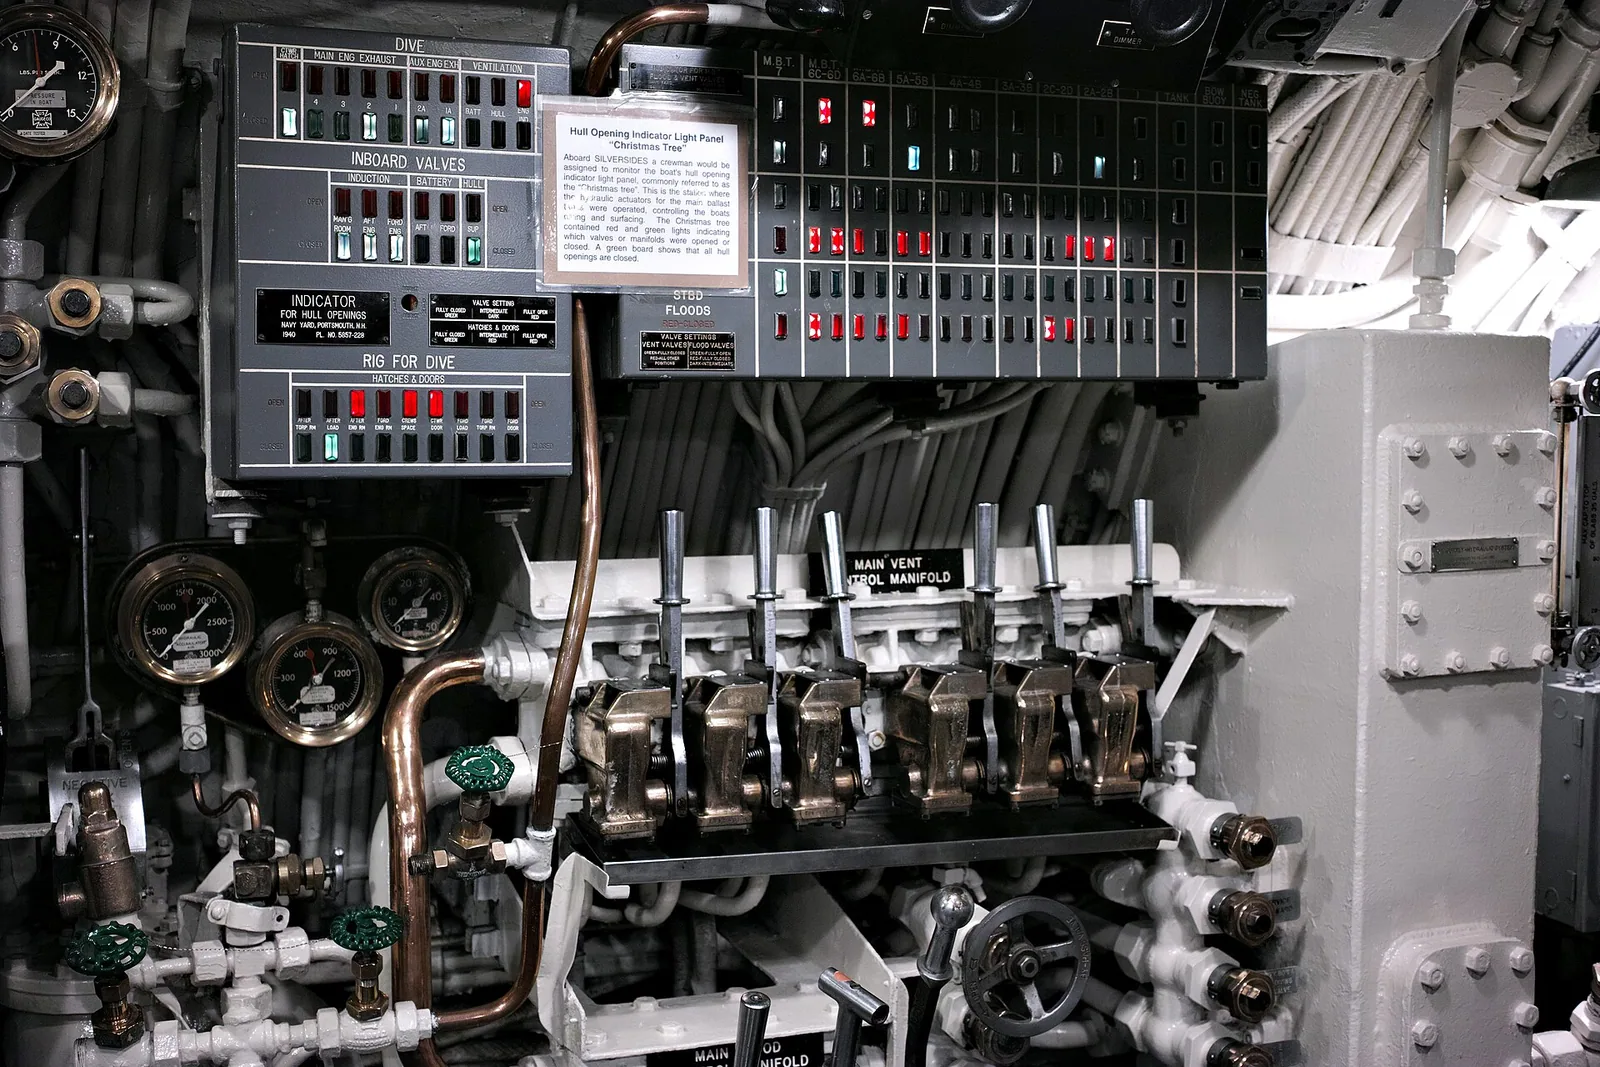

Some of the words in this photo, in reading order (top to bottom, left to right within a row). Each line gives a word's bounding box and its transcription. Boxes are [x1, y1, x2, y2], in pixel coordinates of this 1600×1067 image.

[12, 43, 18, 52] 6
[53, 41, 59, 49] 9
[396, 38, 424, 53] DIVE
[314, 51, 334, 60] MAIN
[338, 53, 355, 62] ENG
[360, 54, 396, 65] EXHAUST
[763, 56, 795, 67] M.B.T.
[409, 58, 425, 67] AUX
[426, 59, 442, 68] ENG
[444, 60, 459, 69] EXH
[473, 62, 523, 73] VENTILATION
[78, 72, 87, 80] 12
[776, 67, 782, 76] 7
[808, 69, 841, 80] 6C-6D
[852, 71, 885, 83] 6A-6B
[896, 75, 928, 86] 5A-5B
[949, 79, 982, 89] 4A-4B
[1001, 82, 1033, 92] 3A-3B
[1043, 84, 1073, 95] 2C-2D
[1084, 87, 1113, 98] 2A-2B
[1204, 86, 1224, 96] BOW
[1241, 89, 1259, 98] NEG
[1164, 92, 1189, 102] TANK
[1202, 95, 1227, 105] BUOY
[1238, 98, 1262, 107] TANK
[67, 109, 76, 117] 15
[491, 110, 505, 118] HULL
[570, 127, 588, 135] Hull
[591, 128, 629, 140] Opening
[632, 130, 672, 140] Indicator
[675, 133, 697, 143] Light
[700, 134, 724, 143] Panel
[352, 152, 407, 168] INBOARD
[416, 157, 465, 171] VALVES
[595, 155, 648, 164] SILVERSIDES
[564, 164, 597, 173] assigned
[660, 168, 681, 176] boat's
[686, 169, 698, 177] hull
[702, 171, 730, 180] opening
[348, 173, 390, 183] INDUCTION
[416, 177, 452, 186] BATTERY
[564, 173, 595, 181] indicator
[598, 175, 613, 184] light
[642, 178, 678, 187] commonly
[463, 179, 482, 188] HULL
[618, 195, 651, 204] actuators
[653, 208, 689, 216] controlling
[611, 216, 645, 224] surfacing.
[676, 217, 711, 225] Christmas
[564, 223, 600, 231] contained
[672, 227, 690, 235] lights
[697, 228, 730, 237] indicating
[692, 238, 718, 246] opened
[564, 253, 597, 262] openings
[673, 290, 703, 300] STBD
[292, 294, 356, 308] INDICATOR
[280, 310, 297, 318] FOR
[302, 310, 322, 319] HULL
[327, 311, 366, 320] OPENINGS
[666, 305, 710, 316] FLOODS
[363, 354, 385, 368] RIG
[393, 355, 417, 368] FOR
[426, 355, 455, 369] DIVE
[372, 374, 410, 383] HATCHES
[412, 375, 417, 383] &
[419, 375, 445, 384] DOORS
[855, 559, 884, 570] MAIN
[891, 557, 922, 569] VENT
[847, 574, 885, 585] NTROL
[890, 572, 950, 585] MANIFOLD
[197, 597, 217, 605] 2000
[430, 592, 441, 600] 40
[158, 603, 176, 611] 1000
[207, 618, 228, 626] 2500
[425, 623, 437, 631] 50
[152, 627, 167, 635] 500
[322, 647, 338, 655] 900
[281, 674, 295, 682] 300
[334, 669, 351, 678] 1200
[326, 703, 344, 712] 1500
[695, 1048, 728, 1062] MAIN
[761, 1055, 809, 1067] NIFOLD
